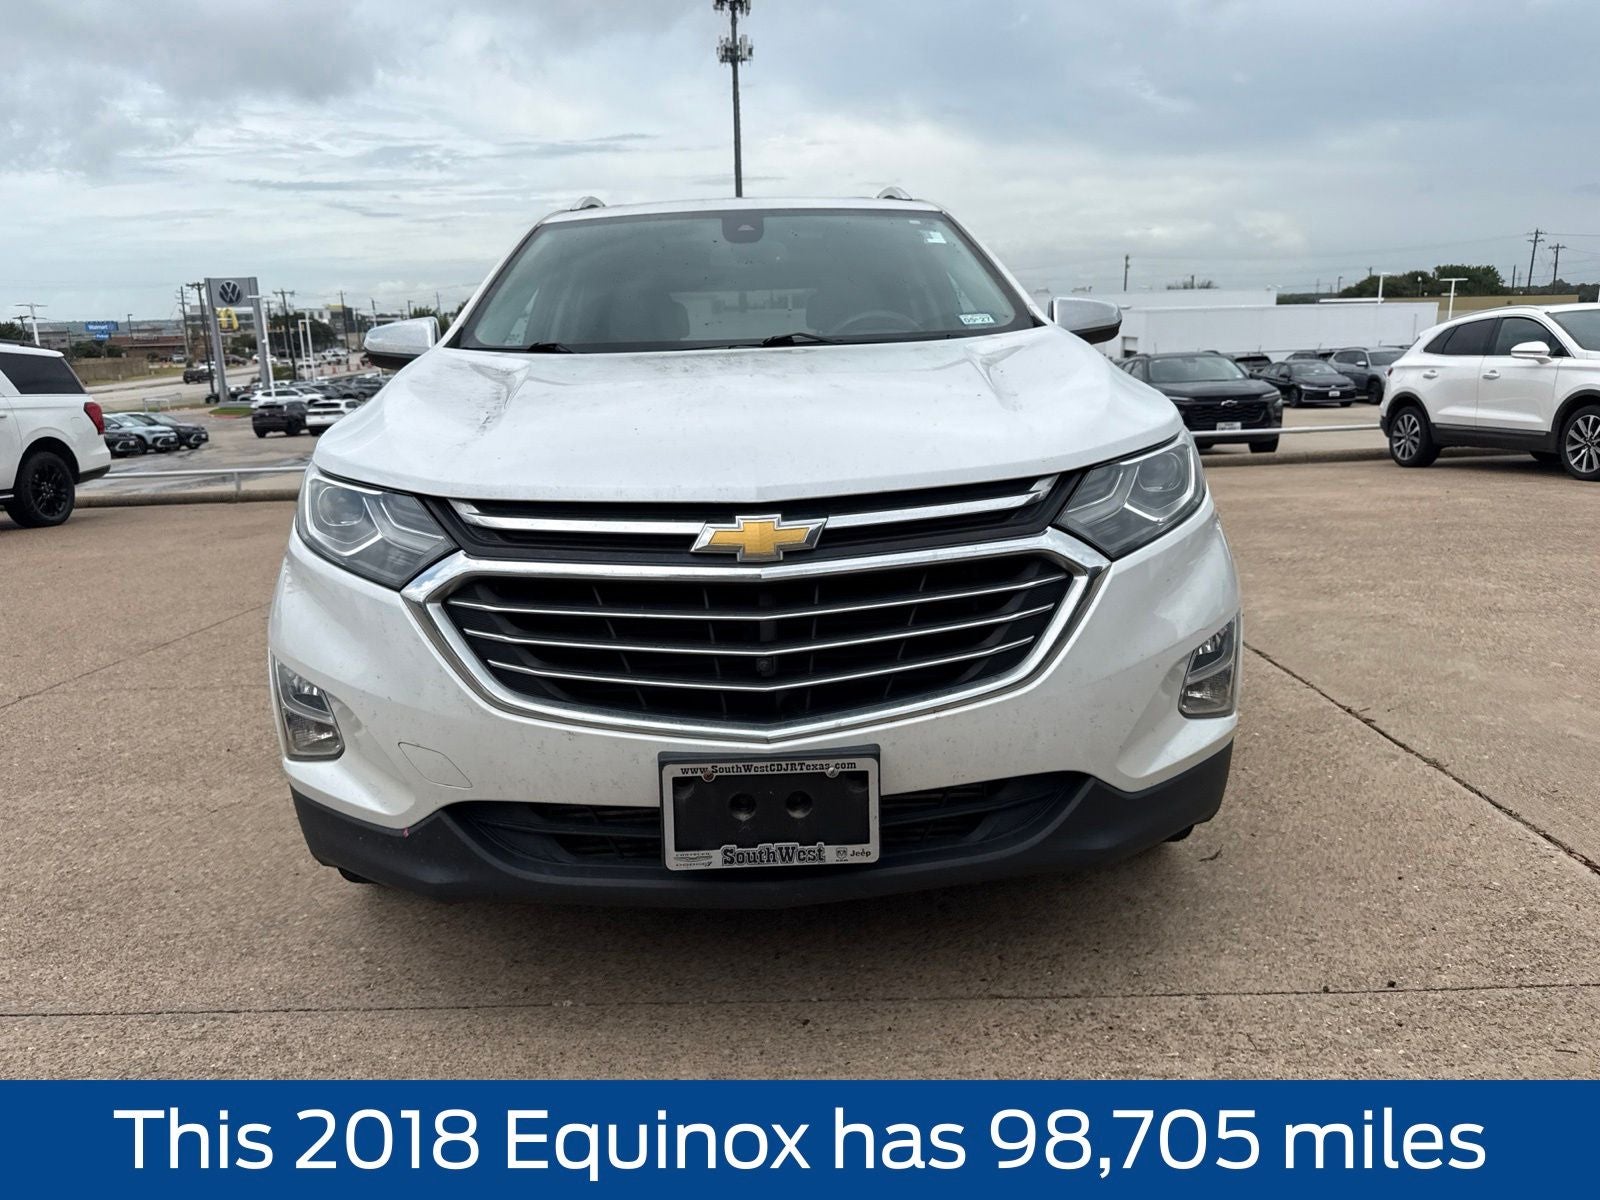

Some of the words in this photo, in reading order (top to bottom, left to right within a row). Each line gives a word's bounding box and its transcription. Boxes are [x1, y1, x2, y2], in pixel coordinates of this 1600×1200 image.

[680, 761, 857, 775] wwwSouthWestCDJRTexascom
[722, 843, 825, 865] SouthWest
[850, 848, 872, 857] Jeep
